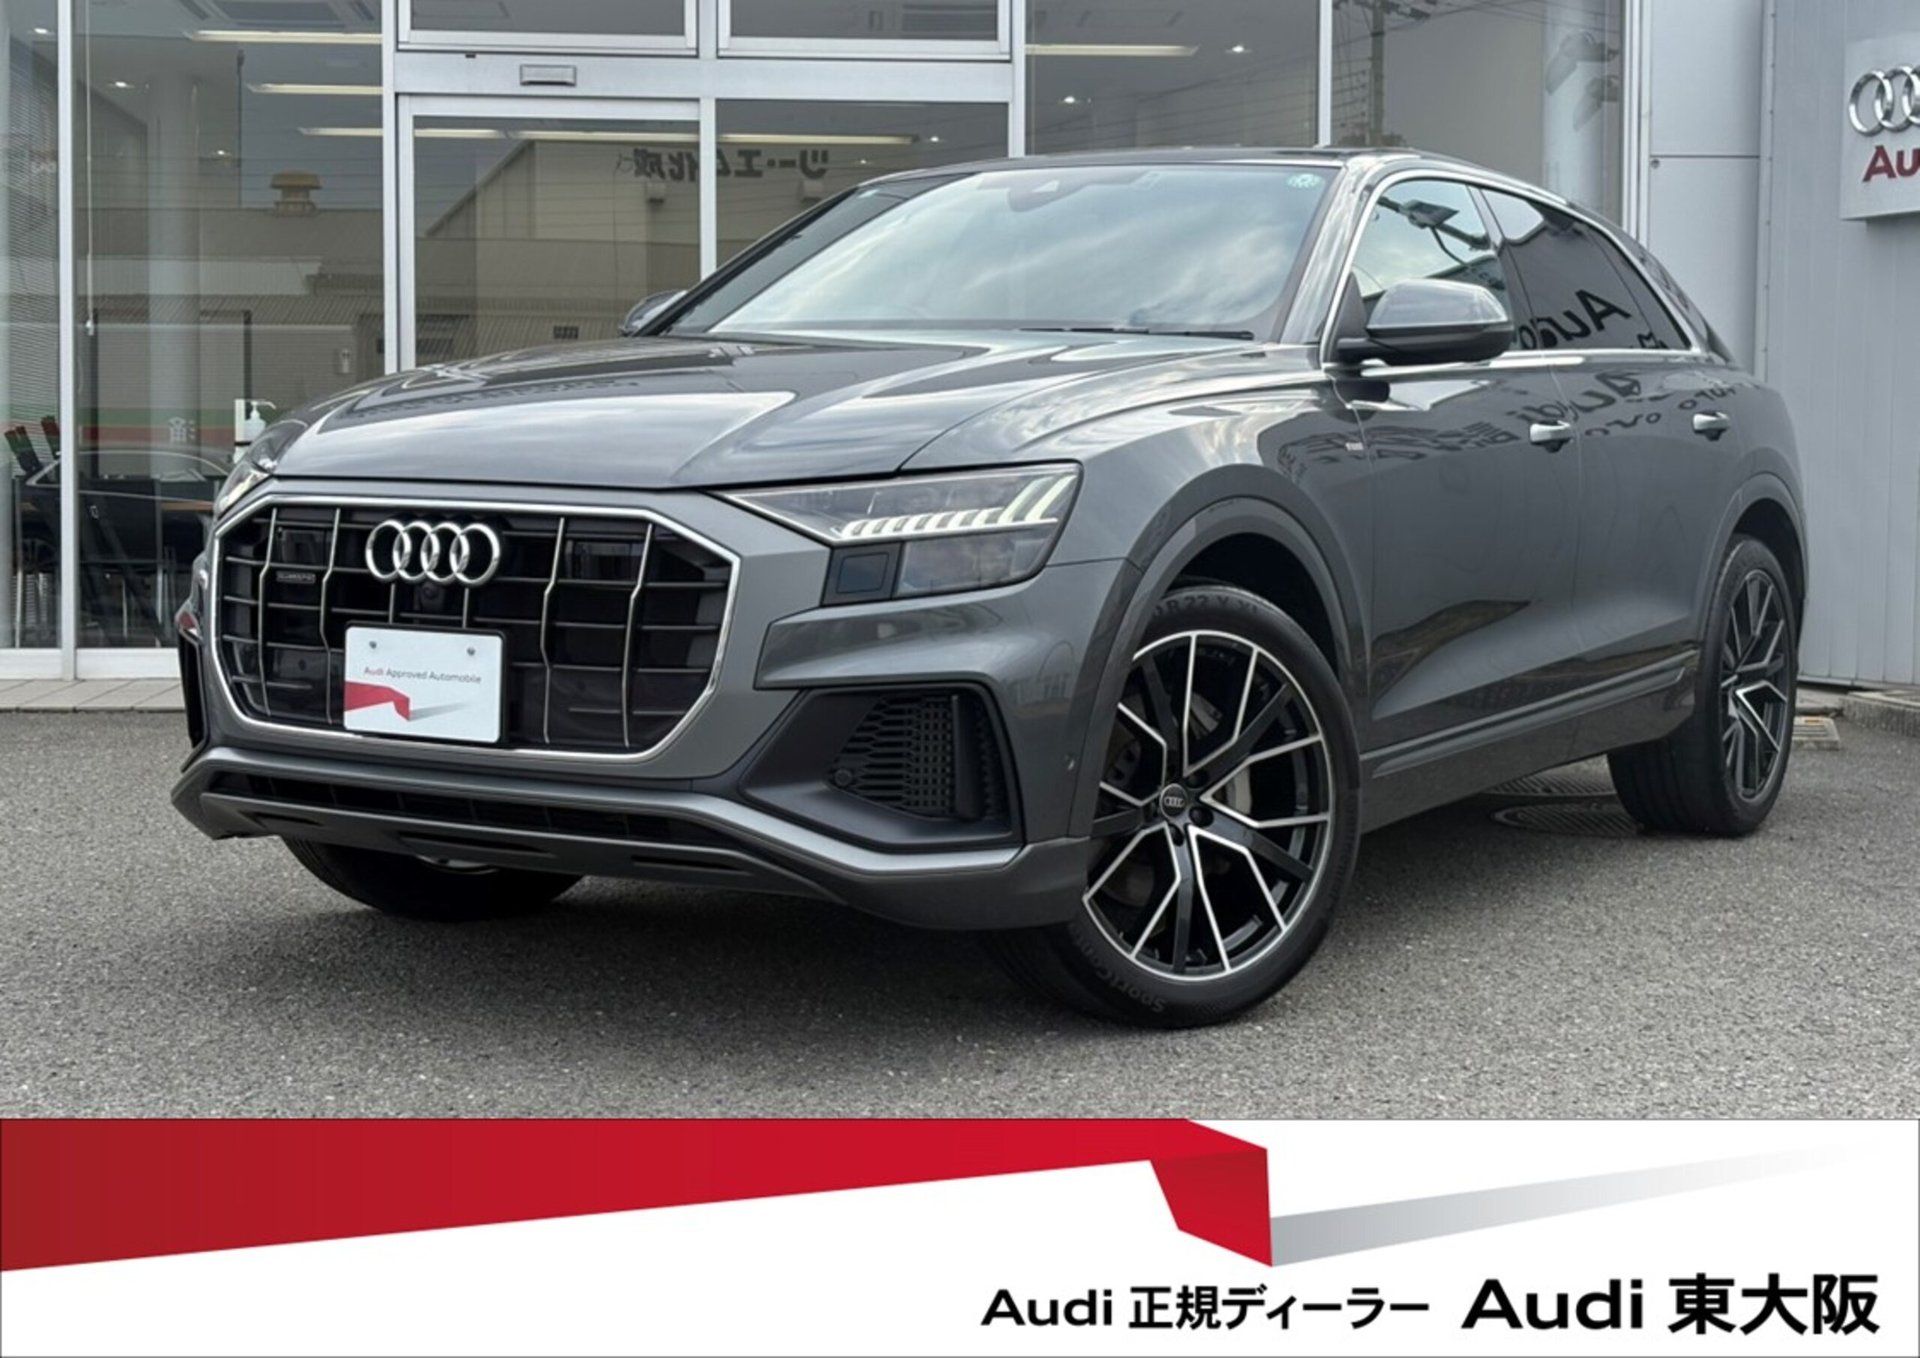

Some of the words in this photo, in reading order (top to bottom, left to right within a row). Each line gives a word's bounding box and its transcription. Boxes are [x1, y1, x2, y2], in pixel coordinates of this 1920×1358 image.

[363, 665, 385, 677] Audi
[386, 667, 428, 681] Approved
[429, 670, 482, 684] Automobile
